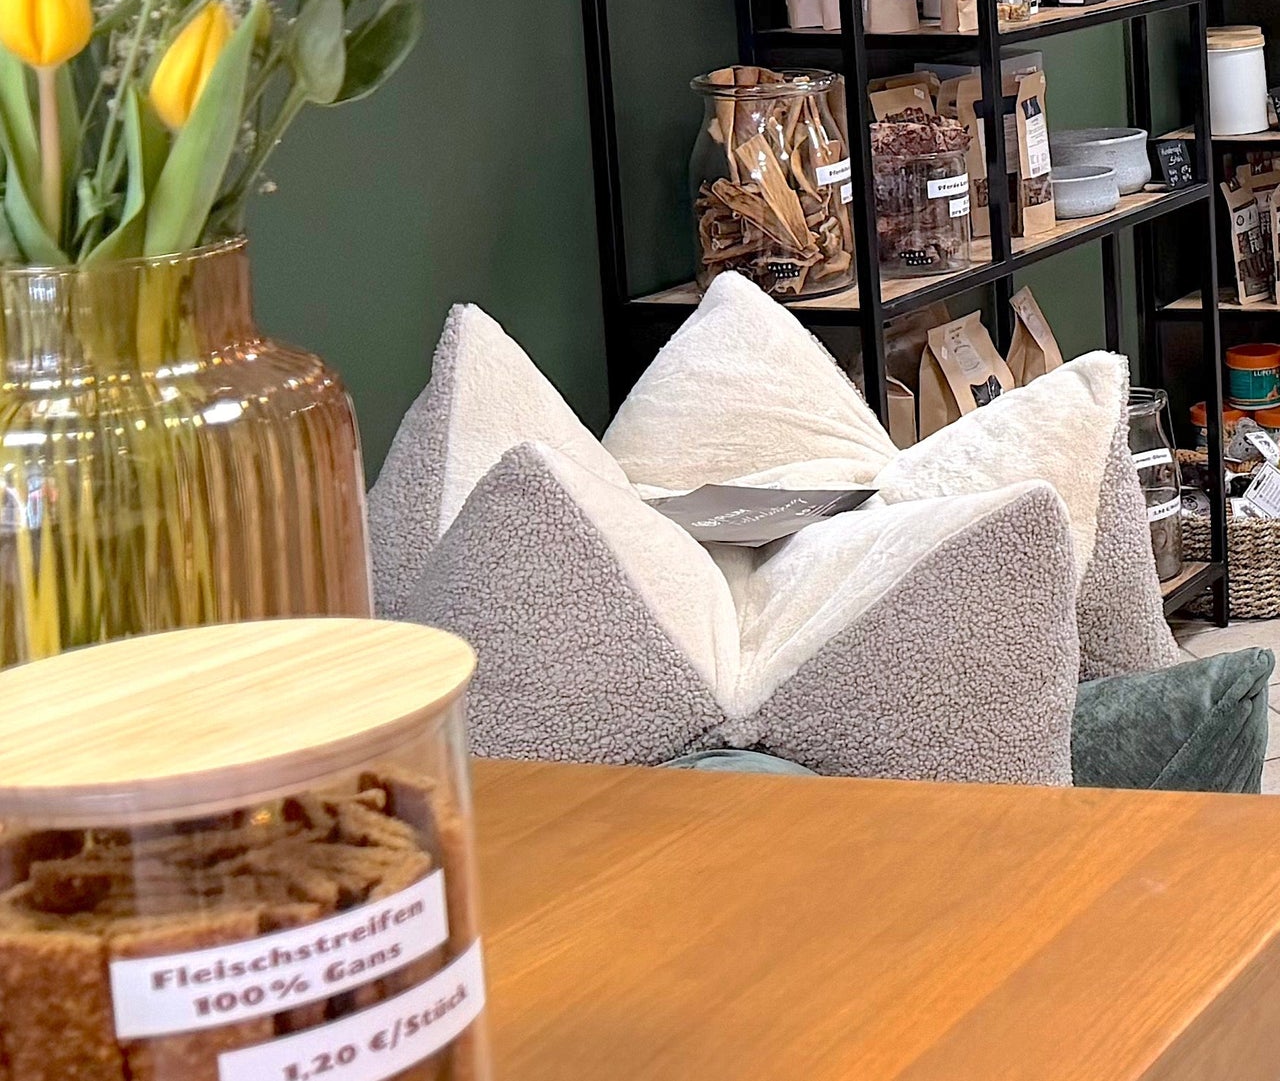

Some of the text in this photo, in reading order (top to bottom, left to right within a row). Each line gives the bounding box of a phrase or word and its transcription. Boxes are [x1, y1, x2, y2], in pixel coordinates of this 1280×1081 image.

[150, 896, 425, 992] Fleischstreifen
[192, 940, 402, 1018] 100% Gans
[282, 983, 468, 1081] 1,20 €/Stück
